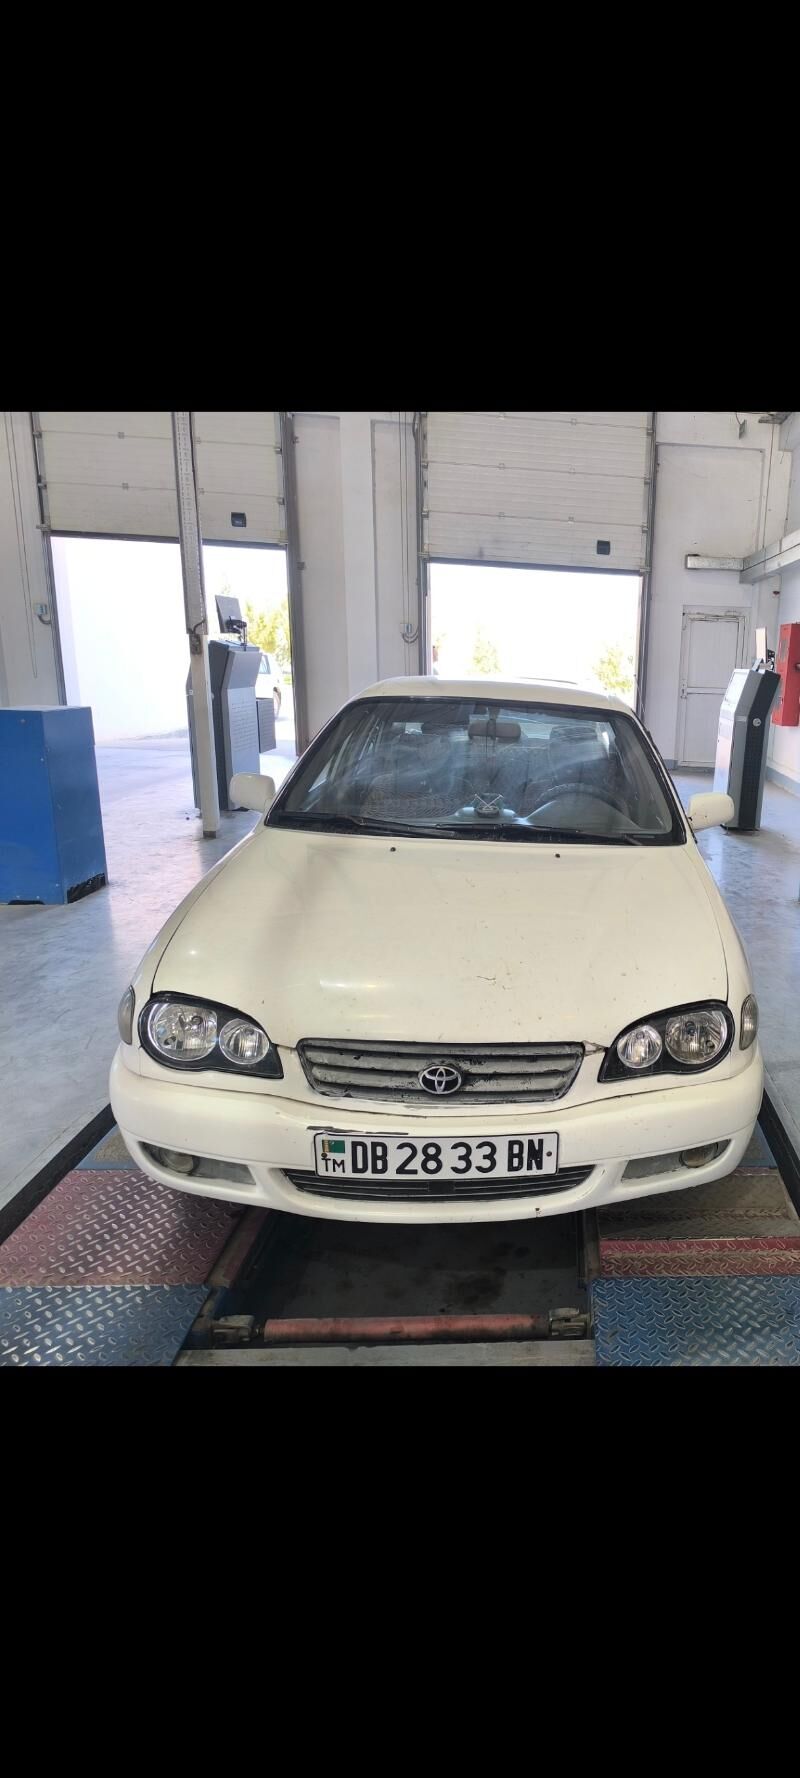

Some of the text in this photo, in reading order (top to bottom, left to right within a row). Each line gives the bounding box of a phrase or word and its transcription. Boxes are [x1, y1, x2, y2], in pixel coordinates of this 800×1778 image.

[322, 1157, 346, 1174] TM
[350, 1138, 544, 1175] DB 28 33 BN
